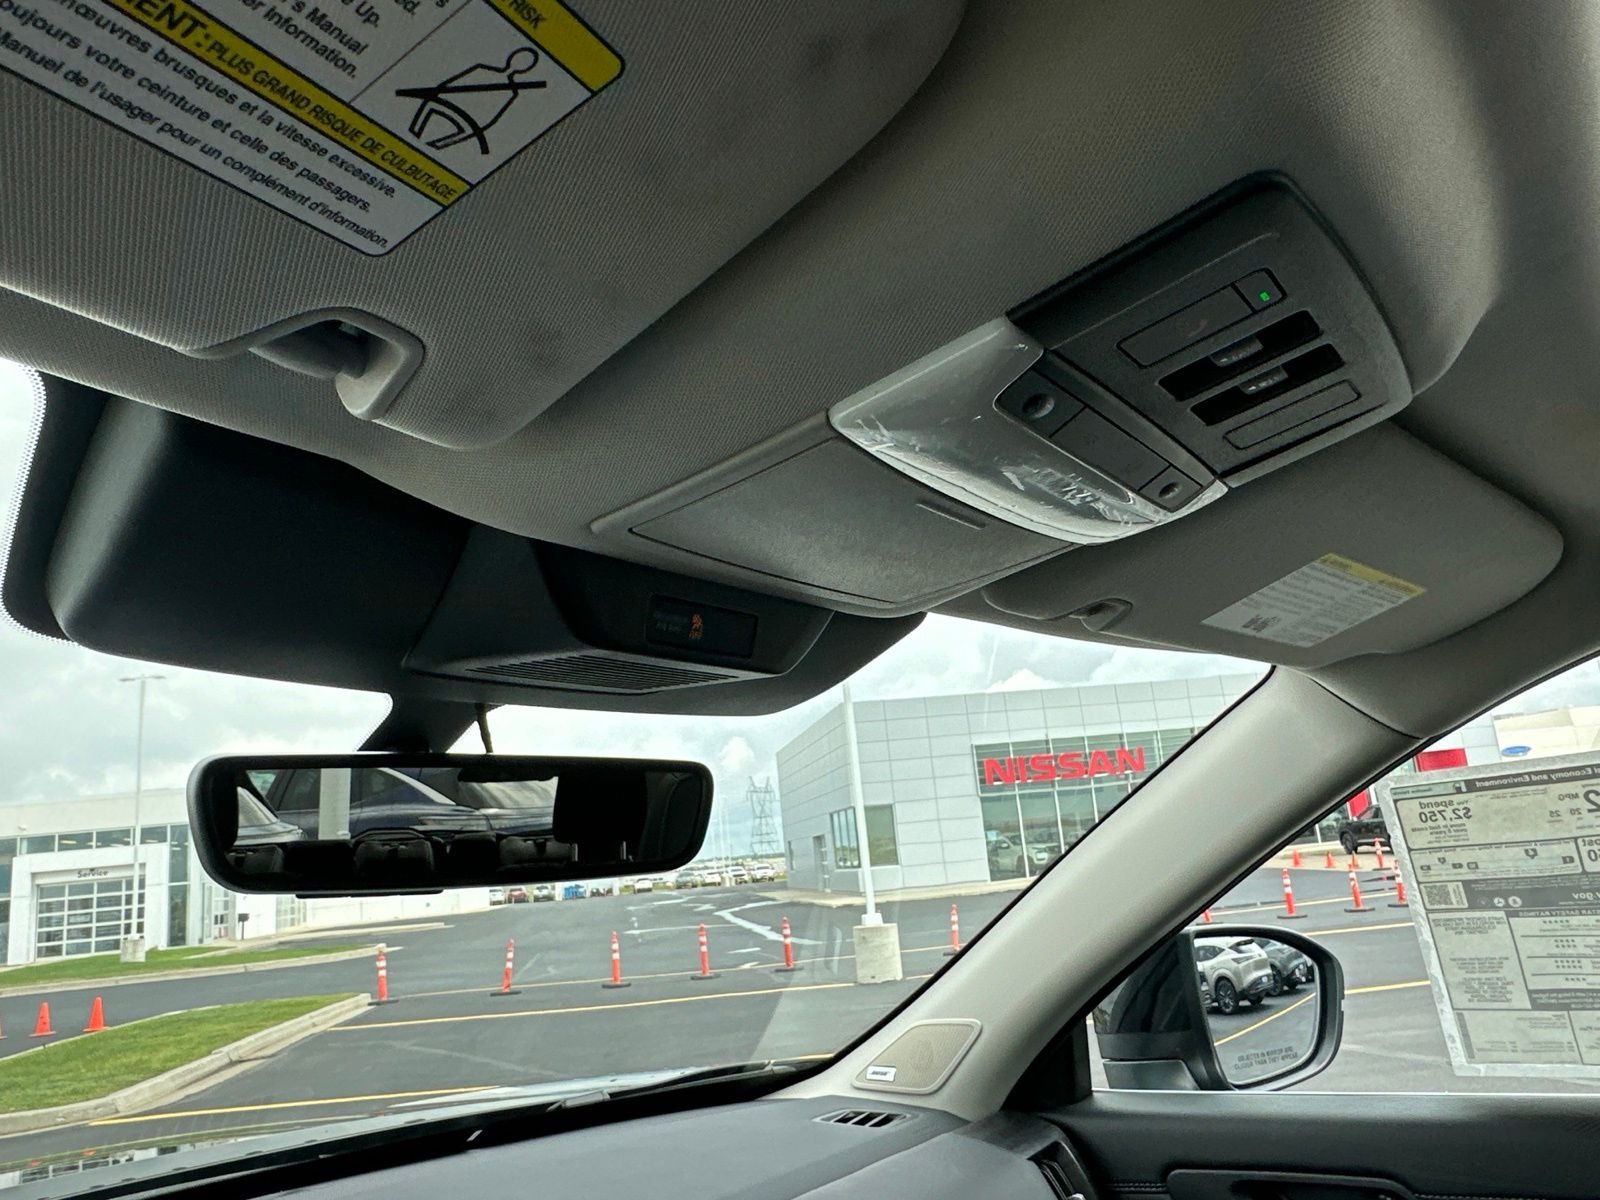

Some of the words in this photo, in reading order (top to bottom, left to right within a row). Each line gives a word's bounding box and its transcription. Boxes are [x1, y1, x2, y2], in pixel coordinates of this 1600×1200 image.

[305, 7, 369, 55] Manual
[355, 0, 380, 28] Up.
[394, 0, 420, 16] d.
[508, 0, 547, 29] RISK
[263, 5, 357, 79] Information.
[85, 44, 136, 79] votre
[137, 76, 211, 122] ceinture
[211, 119, 232, 133] et
[229, 129, 269, 155] celle
[268, 151, 299, 171] des
[295, 167, 371, 213] passagers.
[153, 48, 239, 104] brusques
[238, 101, 259, 116] et
[256, 110, 275, 126] la
[275, 121, 329, 157] vitesse
[328, 153, 396, 198] excessive.
[206, 40, 255, 75] PLUS
[252, 70, 311, 110] GRAND
[308, 104, 365, 142] RISQUE
[360, 137, 385, 155] DE
[380, 149, 458, 200] CULBUTAGE
[63, 69, 89, 88] de
[89, 80, 161, 125] l'usager
[156, 122, 202, 146] pour
[199, 143, 222, 161] un
[222, 156, 312, 206] complément
[308, 201, 389, 248] d'information.
[983, 745, 1145, 785] NISSAN
[77, 869, 109, 879] Service
